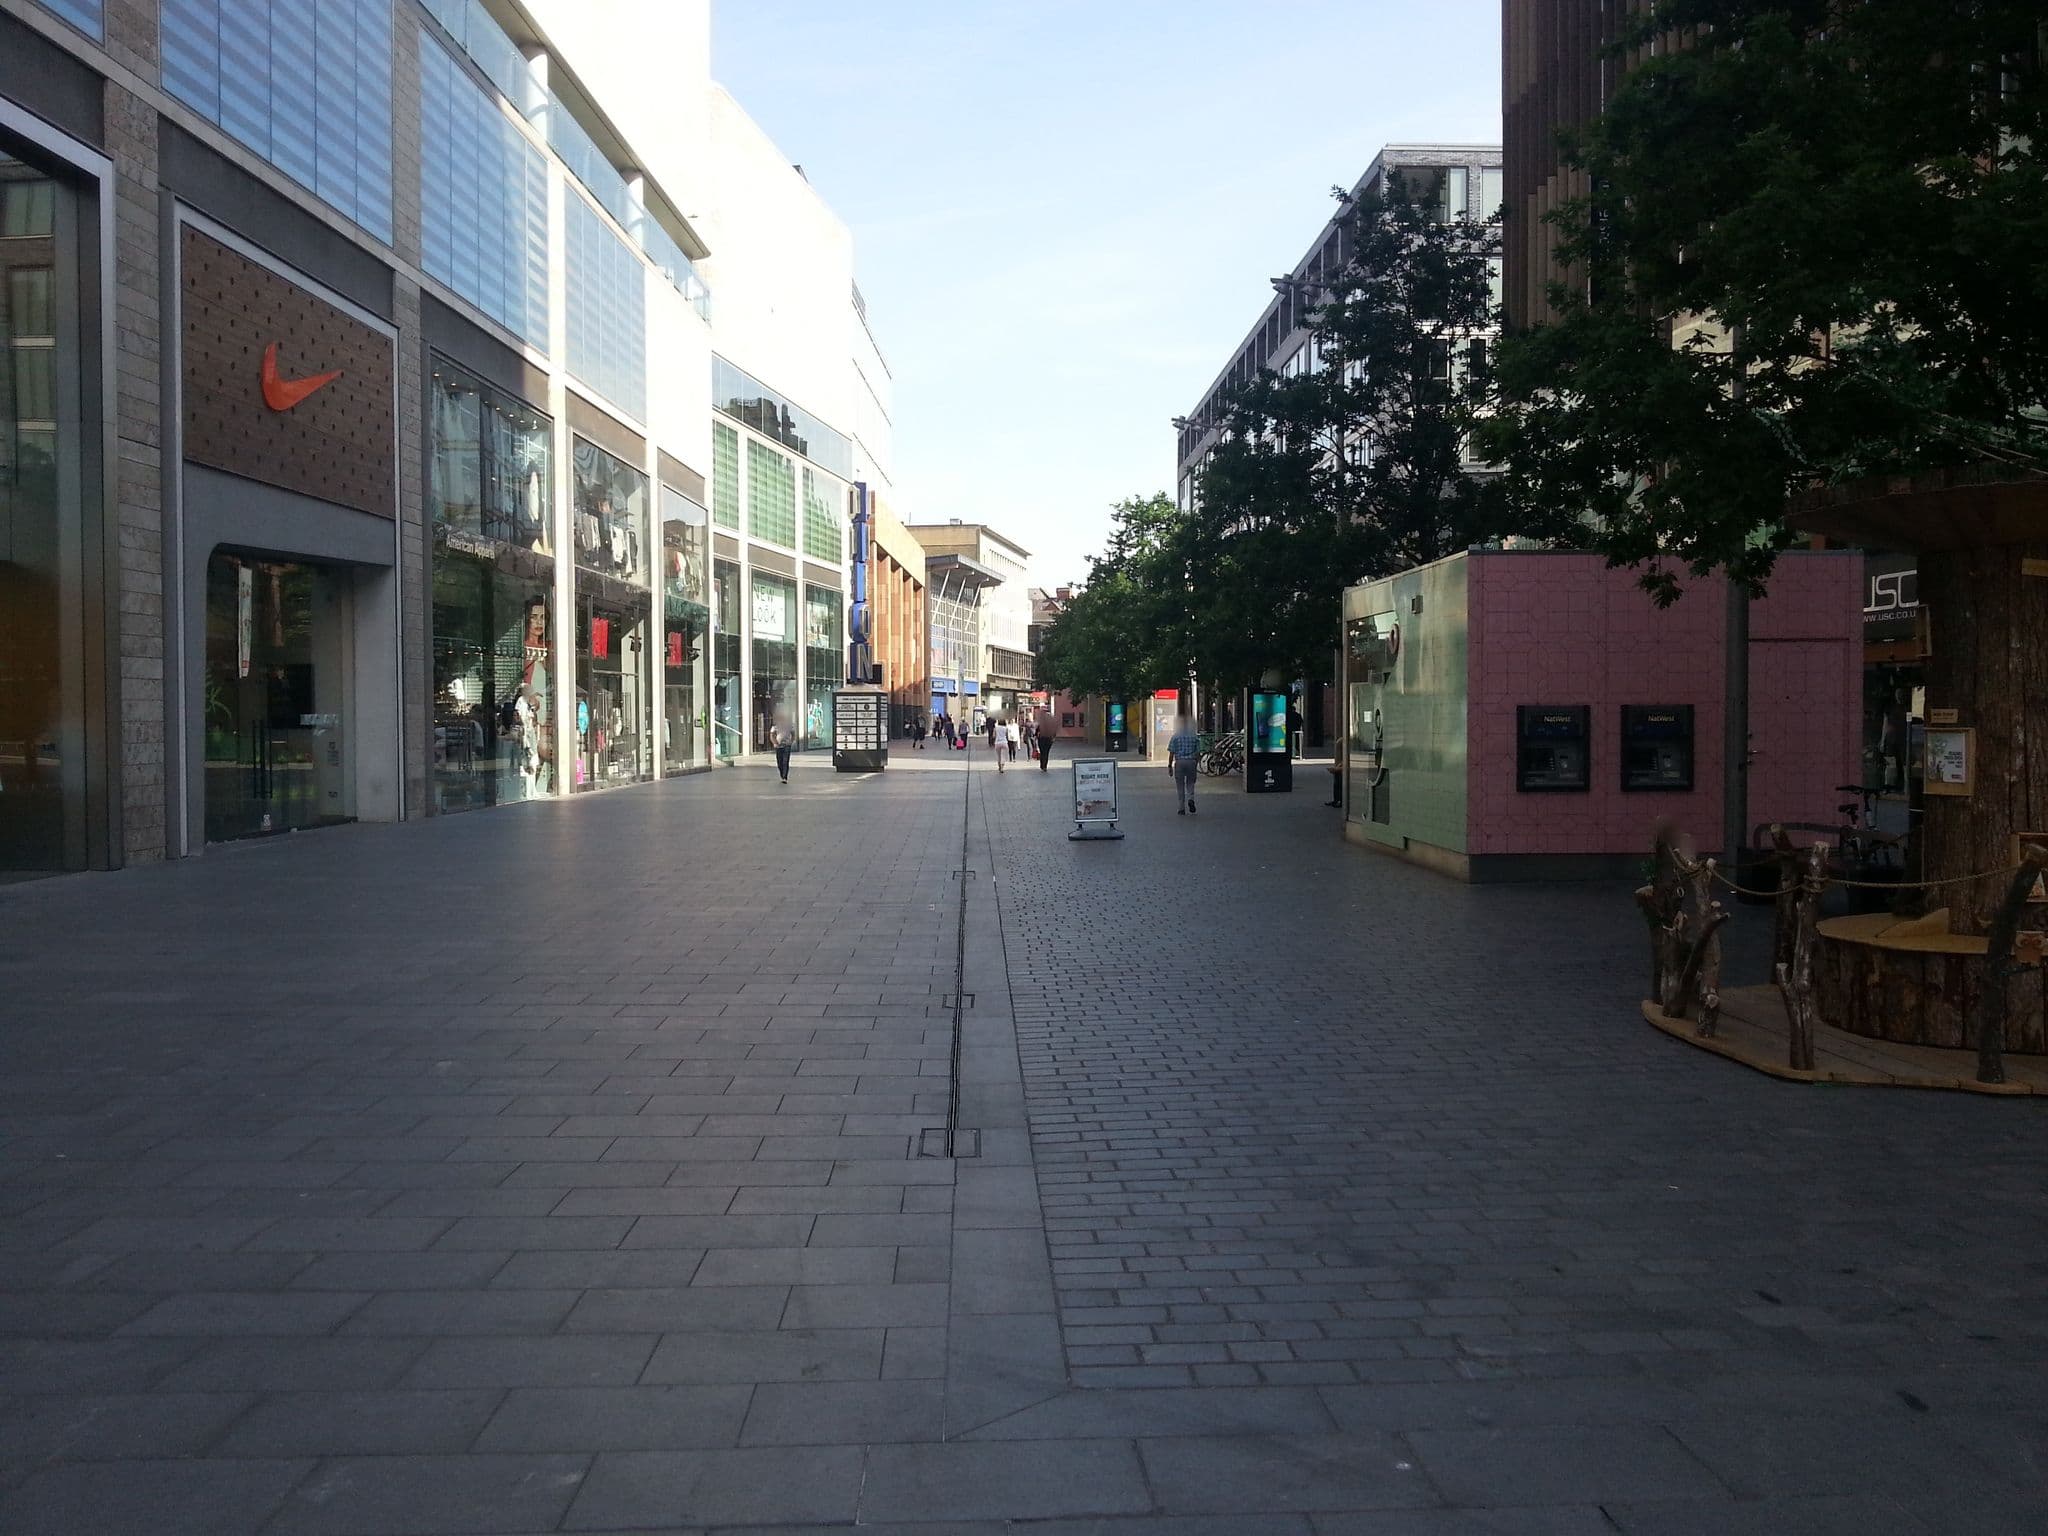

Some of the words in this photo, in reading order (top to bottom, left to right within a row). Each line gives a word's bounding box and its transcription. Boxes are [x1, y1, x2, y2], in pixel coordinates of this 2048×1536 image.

[446, 534, 474, 554] American
[753, 583, 774, 602] NEW
[752, 606, 776, 623] LOOK
[1543, 715, 1571, 723] NatWest
[1647, 714, 1675, 722] NatWest
